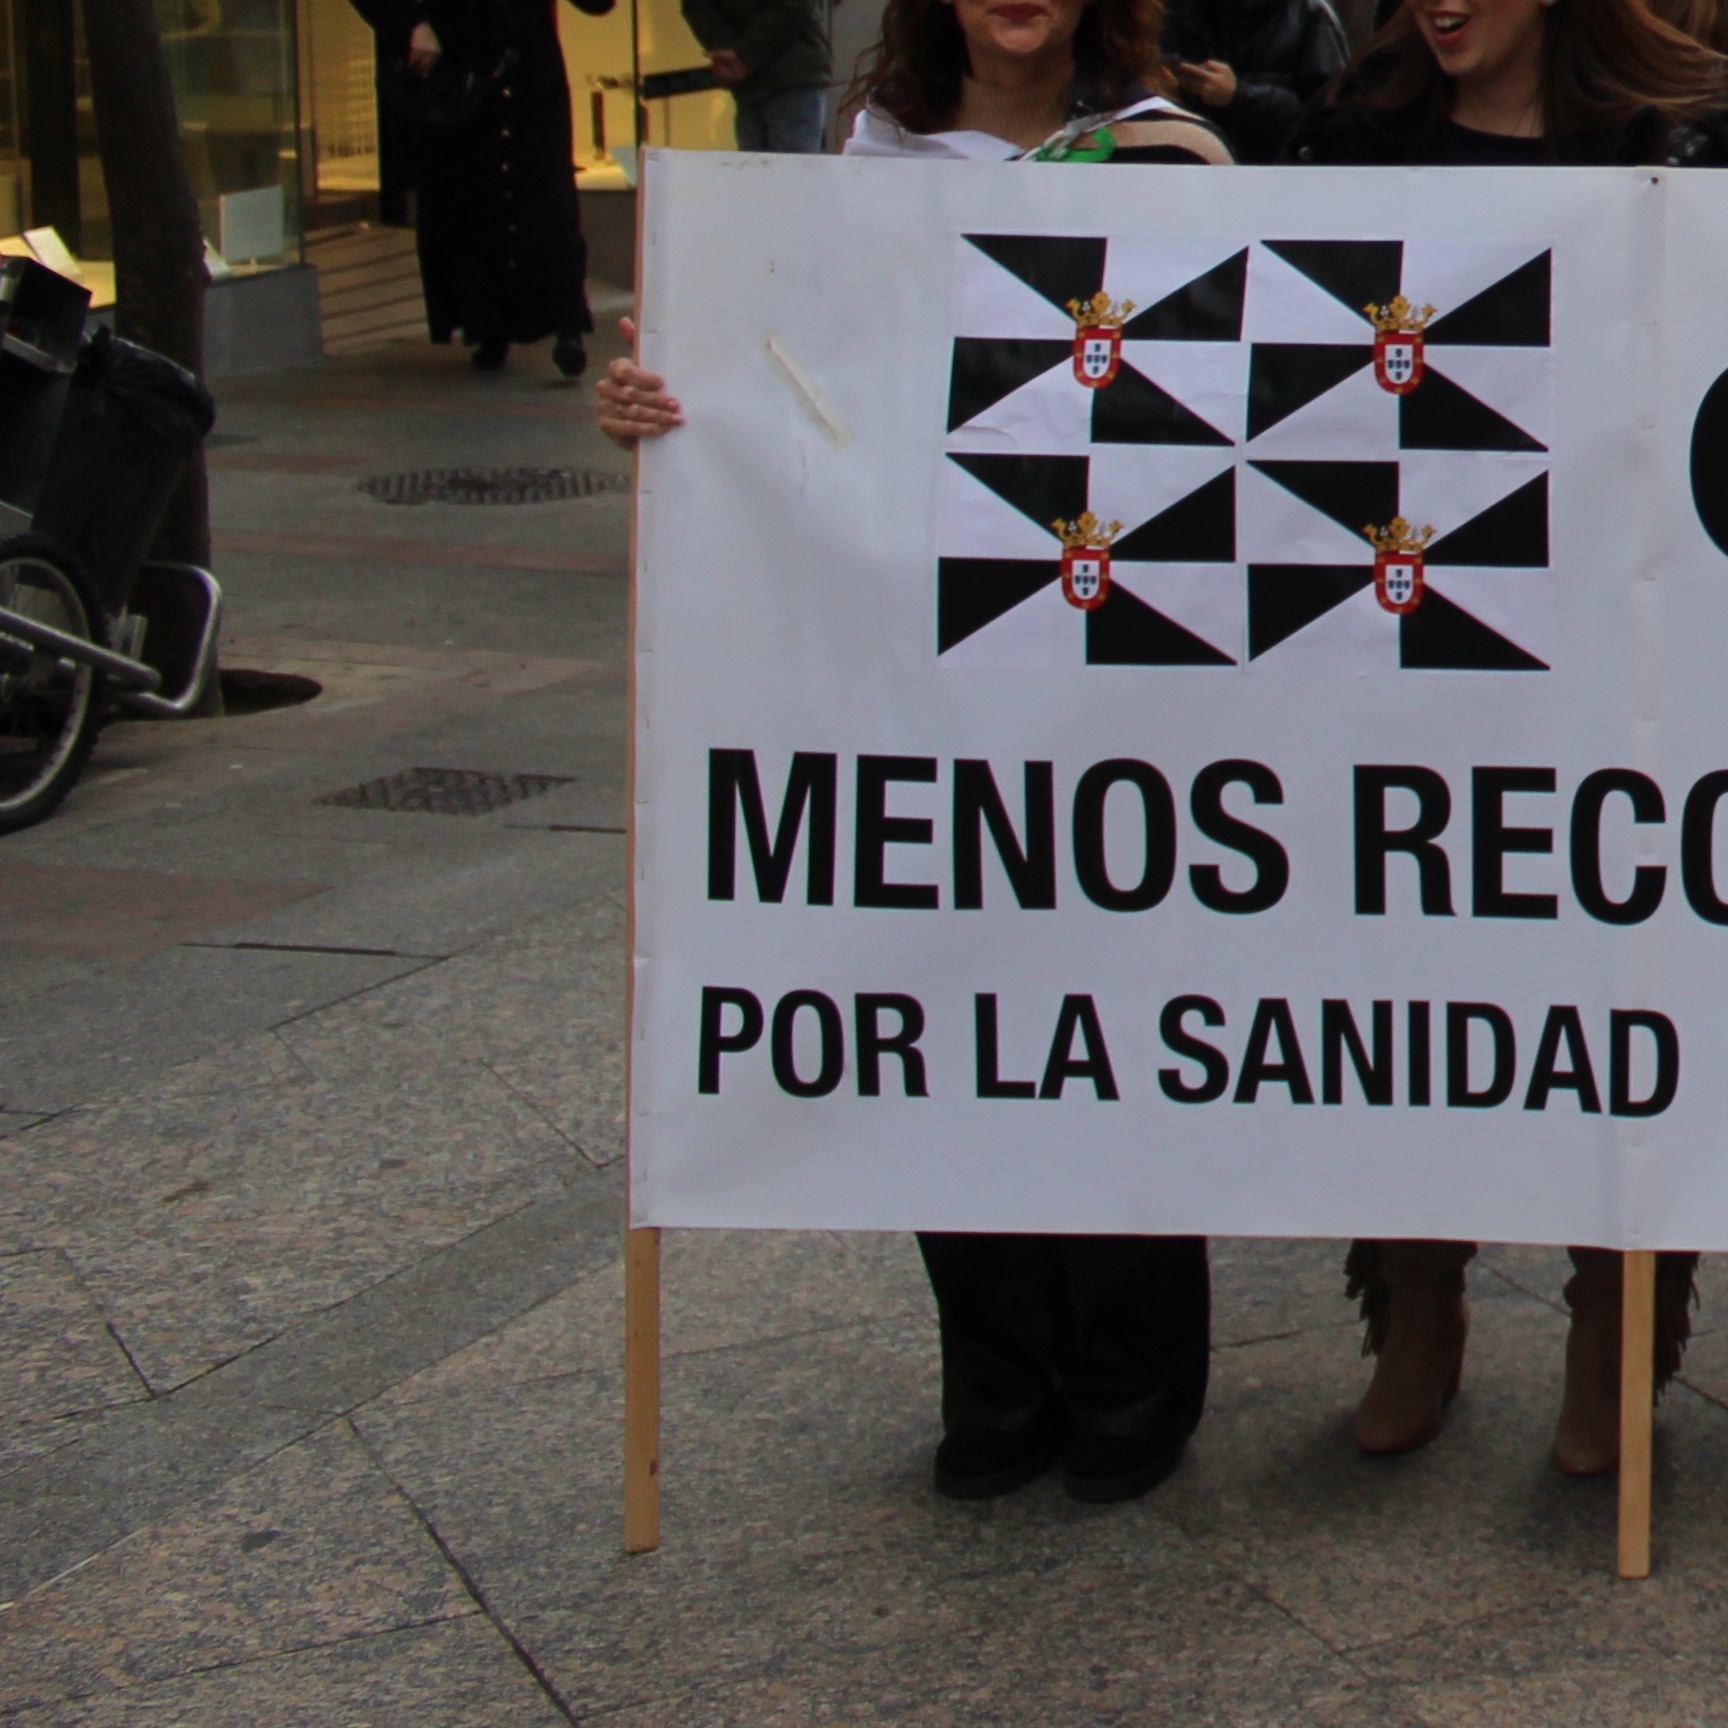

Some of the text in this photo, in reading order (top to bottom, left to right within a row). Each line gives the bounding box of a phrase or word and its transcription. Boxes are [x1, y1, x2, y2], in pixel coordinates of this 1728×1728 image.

[708, 748, 1290, 914] MENOS
[698, 985, 929, 1099] POR
[974, 992, 1120, 1102] LA
[1157, 993, 1680, 1118] SANIDAD
